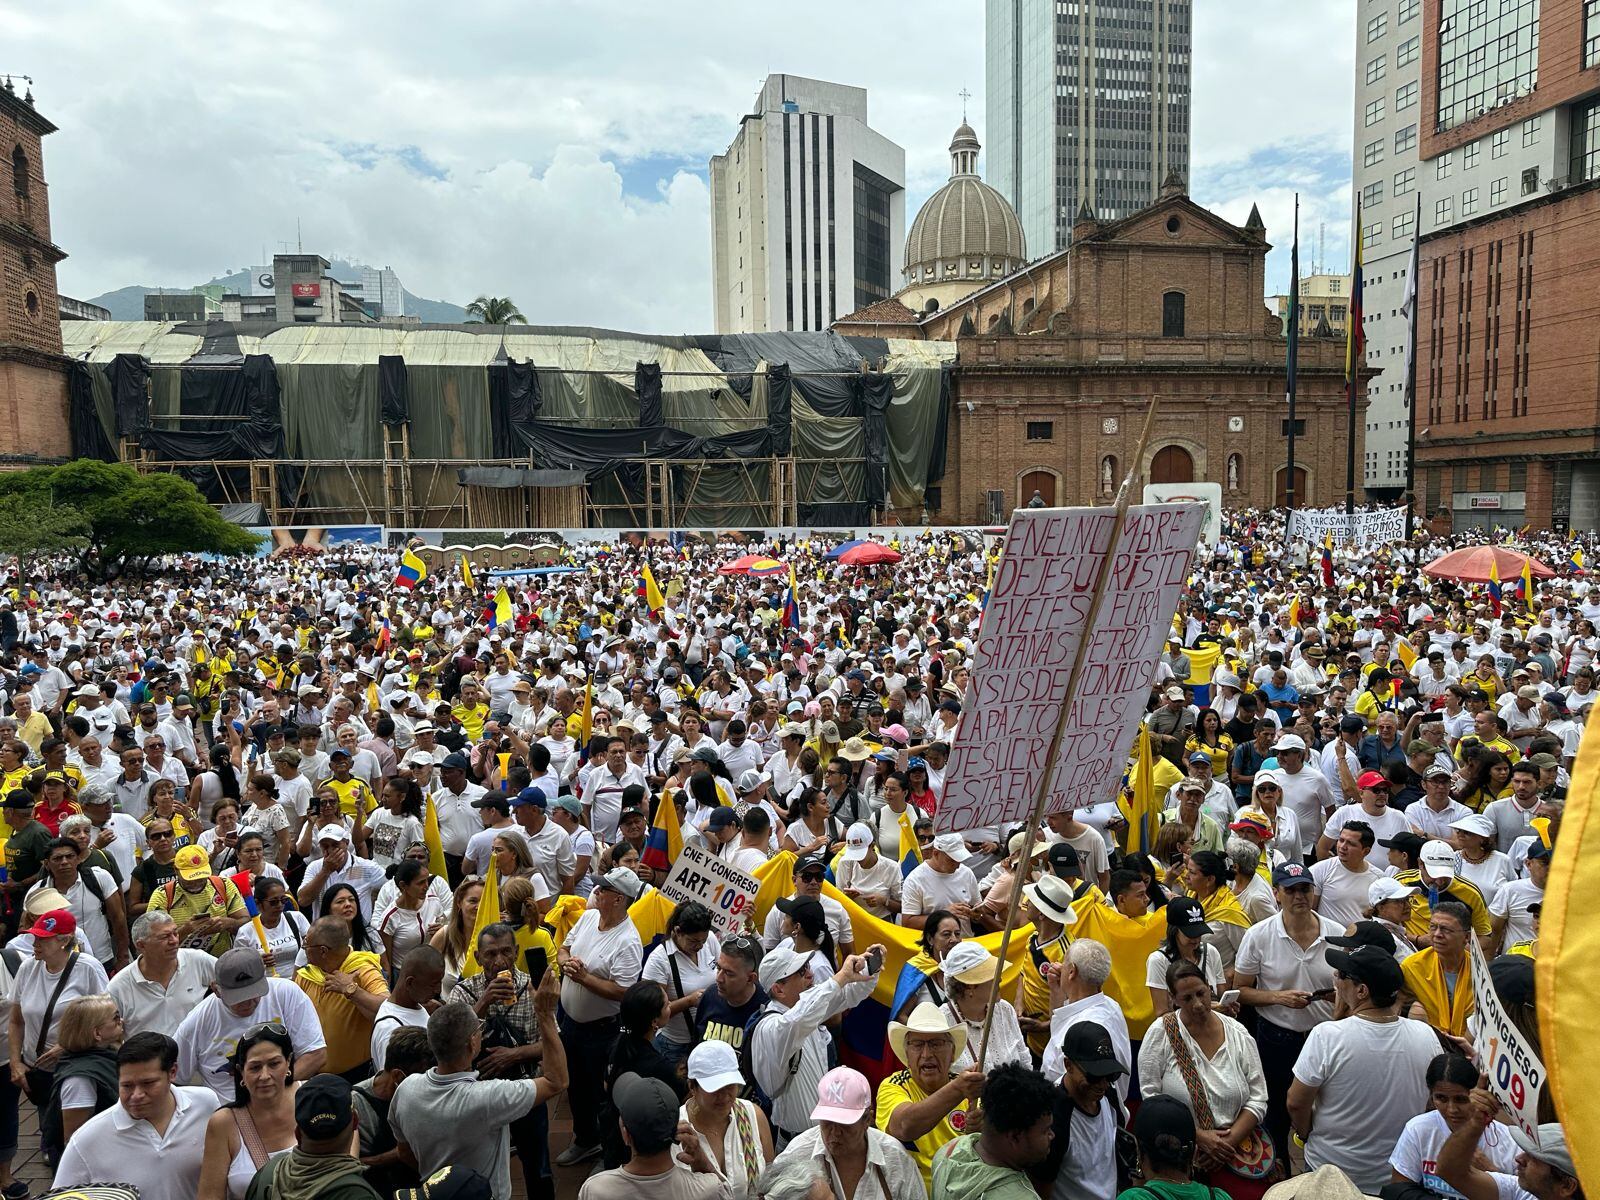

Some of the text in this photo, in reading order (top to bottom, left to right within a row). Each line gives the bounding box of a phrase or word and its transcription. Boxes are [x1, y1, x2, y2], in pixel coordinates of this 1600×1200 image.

[1329, 515, 1362, 526] SANTOS
[1366, 510, 1399, 524] EMPEZO
[1362, 519, 1403, 534] PEDIMOS
[1367, 530, 1403, 543] REMIO
[1028, 700, 1092, 735] TOAL
[683, 846, 759, 895] CNE Y CONGRESO
[674, 867, 746, 916] ART. 109
[728, 916, 740, 934] YA
[255, 935, 296, 950] LNDON
[1480, 971, 1486, 990] Y
[1485, 988, 1539, 1089] CONGRESO
[1488, 1037, 1525, 1110] 109
[310, 1113, 337, 1124] VETERANO
